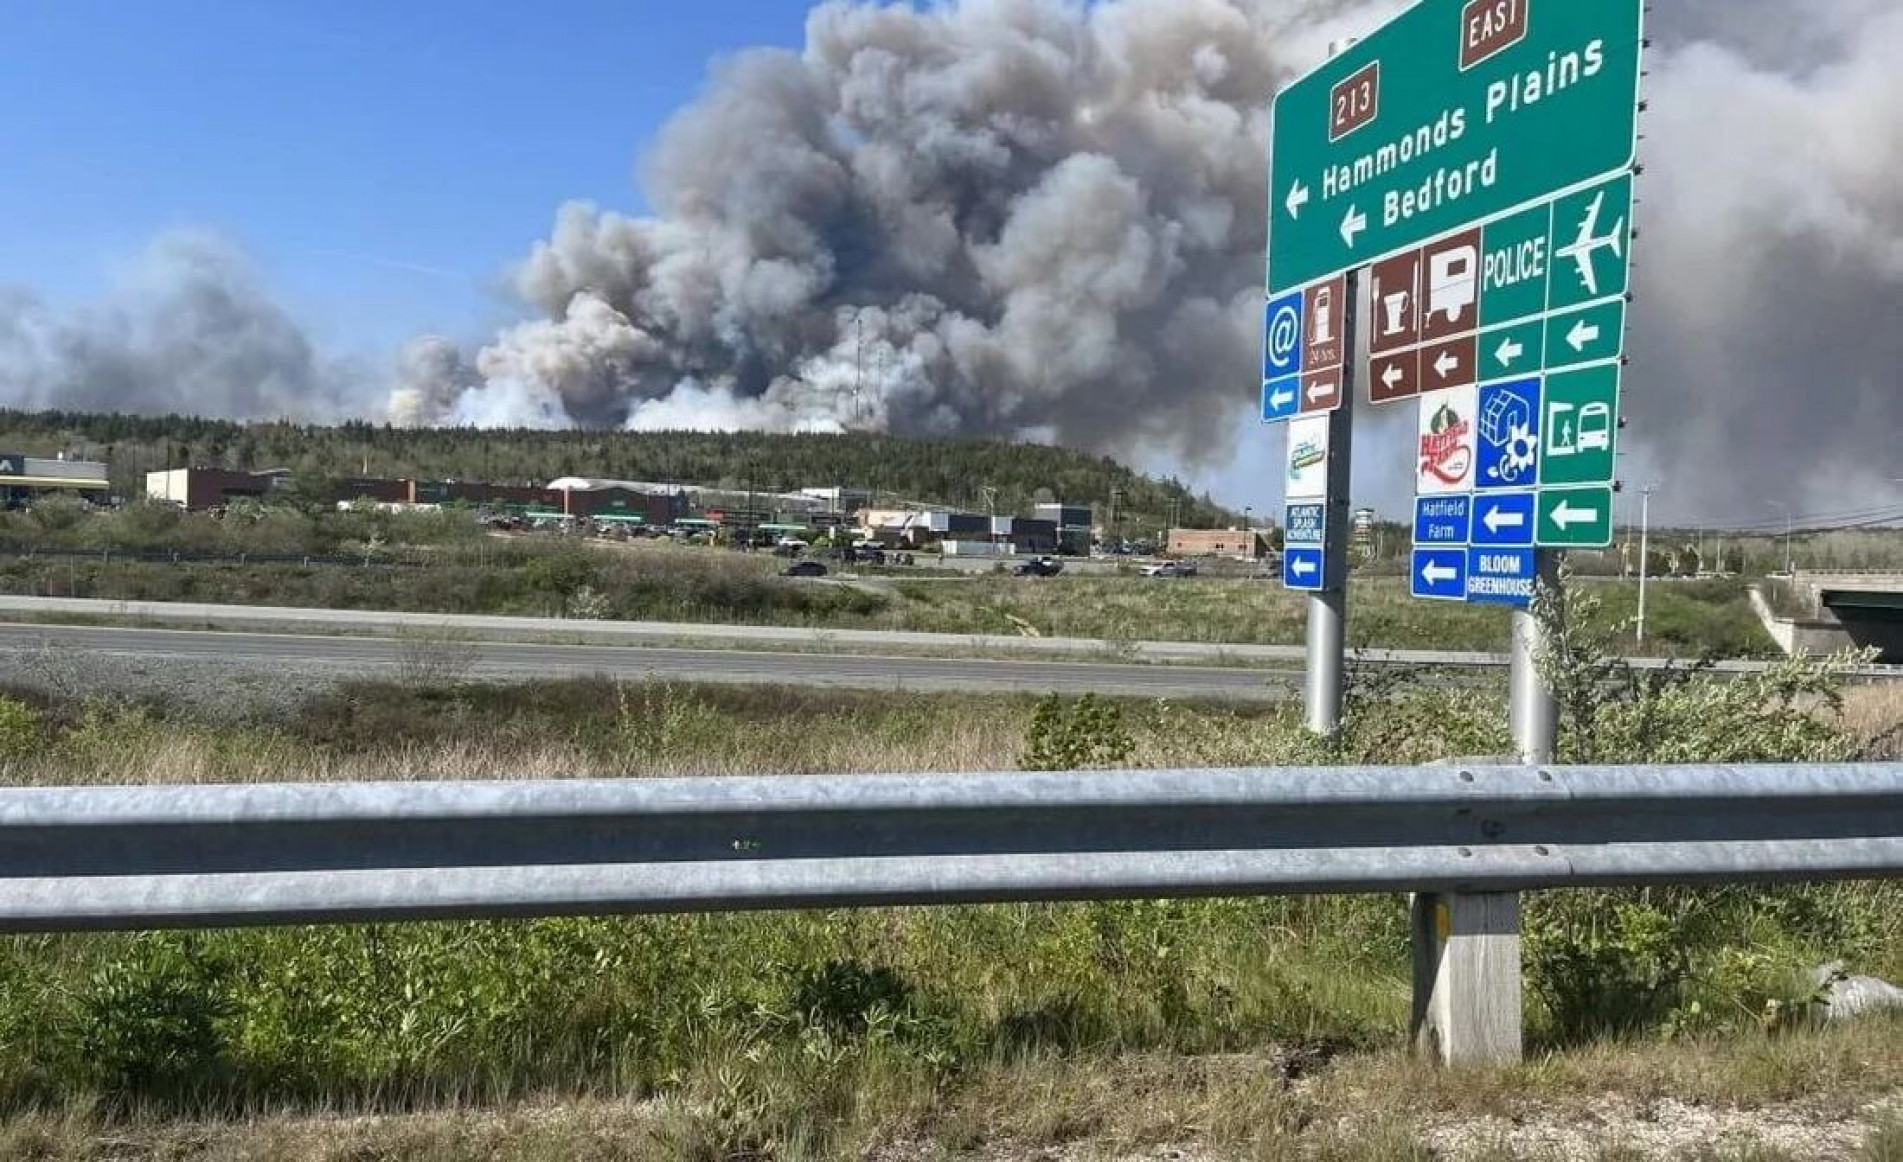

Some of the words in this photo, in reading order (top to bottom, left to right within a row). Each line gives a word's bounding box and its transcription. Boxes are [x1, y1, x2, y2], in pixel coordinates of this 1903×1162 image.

[1469, 0, 1517, 48] EAST
[1322, 108, 1466, 200] Hammonds
[1486, 38, 1603, 124] Plains
[1336, 81, 1371, 126] 213
[1383, 147, 1498, 227] Bedford
[1483, 236, 1547, 292] POLICE
[1422, 500, 1465, 516] Hatfield
[1428, 523, 1454, 539] Farm
[1468, 577, 1533, 596] GREENHOUSE
[1480, 555, 1520, 573] BLOOM
